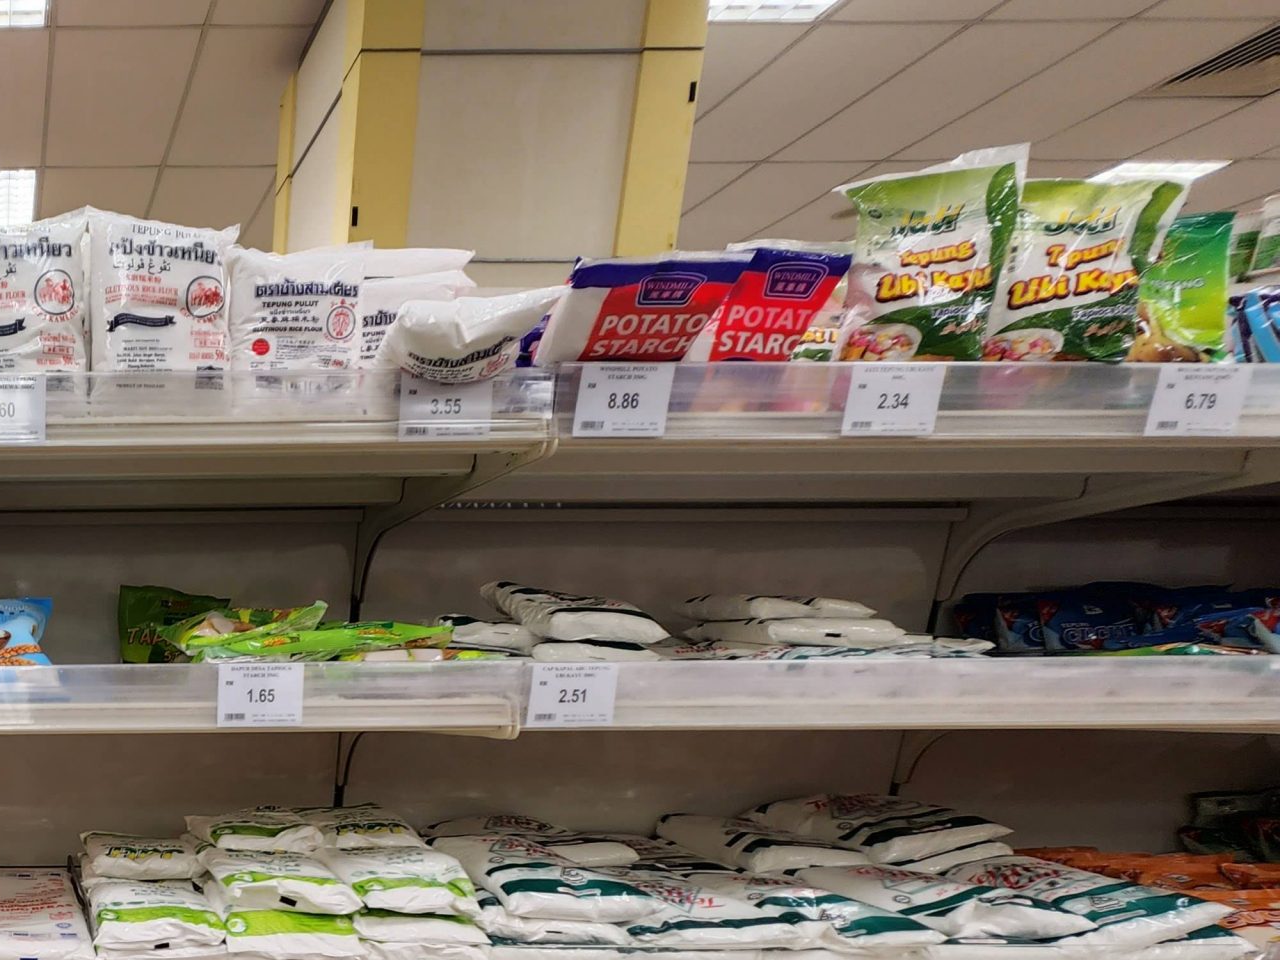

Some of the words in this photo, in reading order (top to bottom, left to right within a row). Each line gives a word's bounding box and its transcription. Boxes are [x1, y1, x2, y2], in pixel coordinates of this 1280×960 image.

[774, 271, 817, 282] WINDMILL
[646, 280, 696, 290] WINDMILL
[1008, 276, 1070, 309] Ubi
[1074, 268, 1139, 296] Kayu
[598, 313, 709, 336] POTATO
[589, 336, 697, 357] STARCH
[430, 398, 461, 414] 3.55
[608, 393, 639, 409] 8.86
[877, 393, 909, 410] 2.34
[1185, 393, 1216, 410] 6.79
[247, 689, 275, 703] 1.65
[558, 689, 588, 703] 2.51
